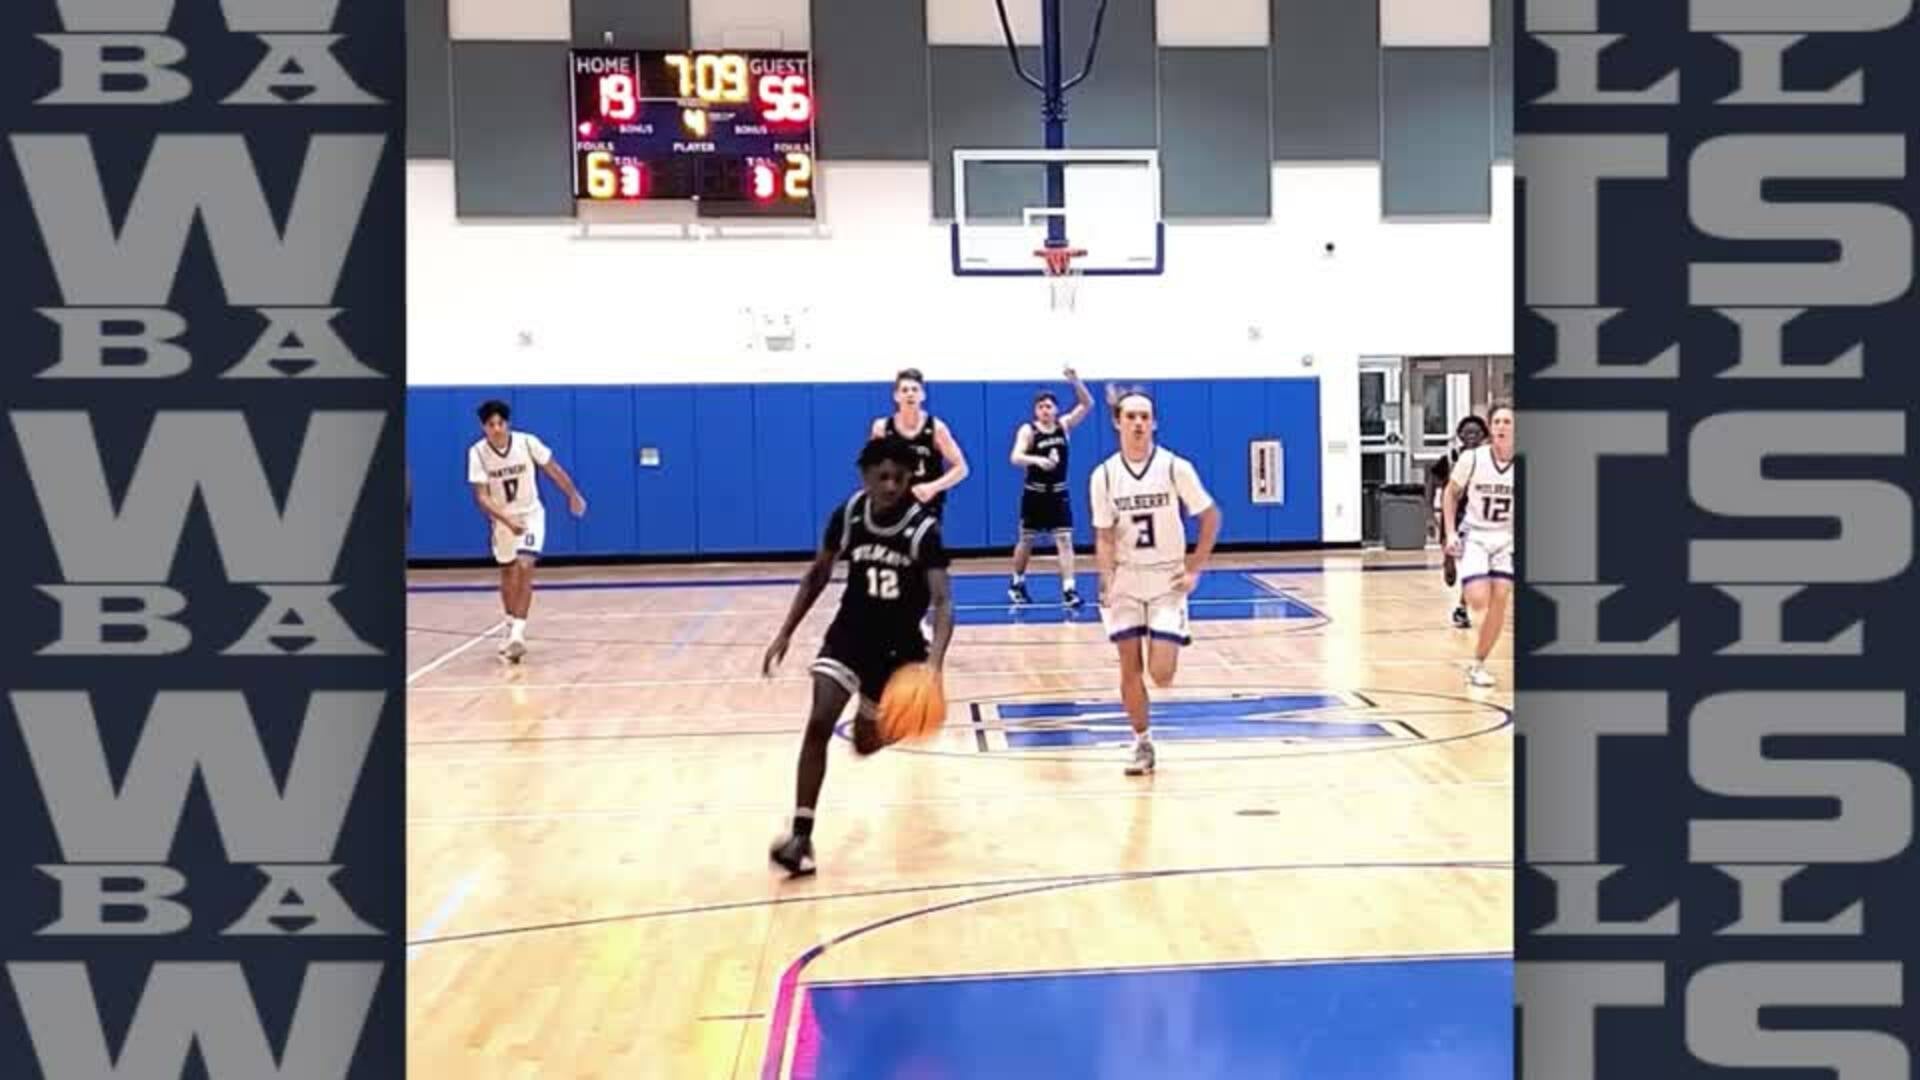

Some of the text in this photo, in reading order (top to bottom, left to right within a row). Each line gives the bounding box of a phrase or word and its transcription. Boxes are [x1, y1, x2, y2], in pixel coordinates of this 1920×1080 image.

[576, 57, 630, 73] HOME
[750, 58, 806, 74] GUEST
[600, 74, 636, 119] 19
[759, 75, 810, 121] 56
[673, 142, 715, 152] PLAYER
[587, 151, 616, 198] 6
[784, 153, 811, 198] 2
[1481, 496, 1511, 522] 12
[1131, 514, 1156, 548] 3
[867, 566, 900, 599] 12
